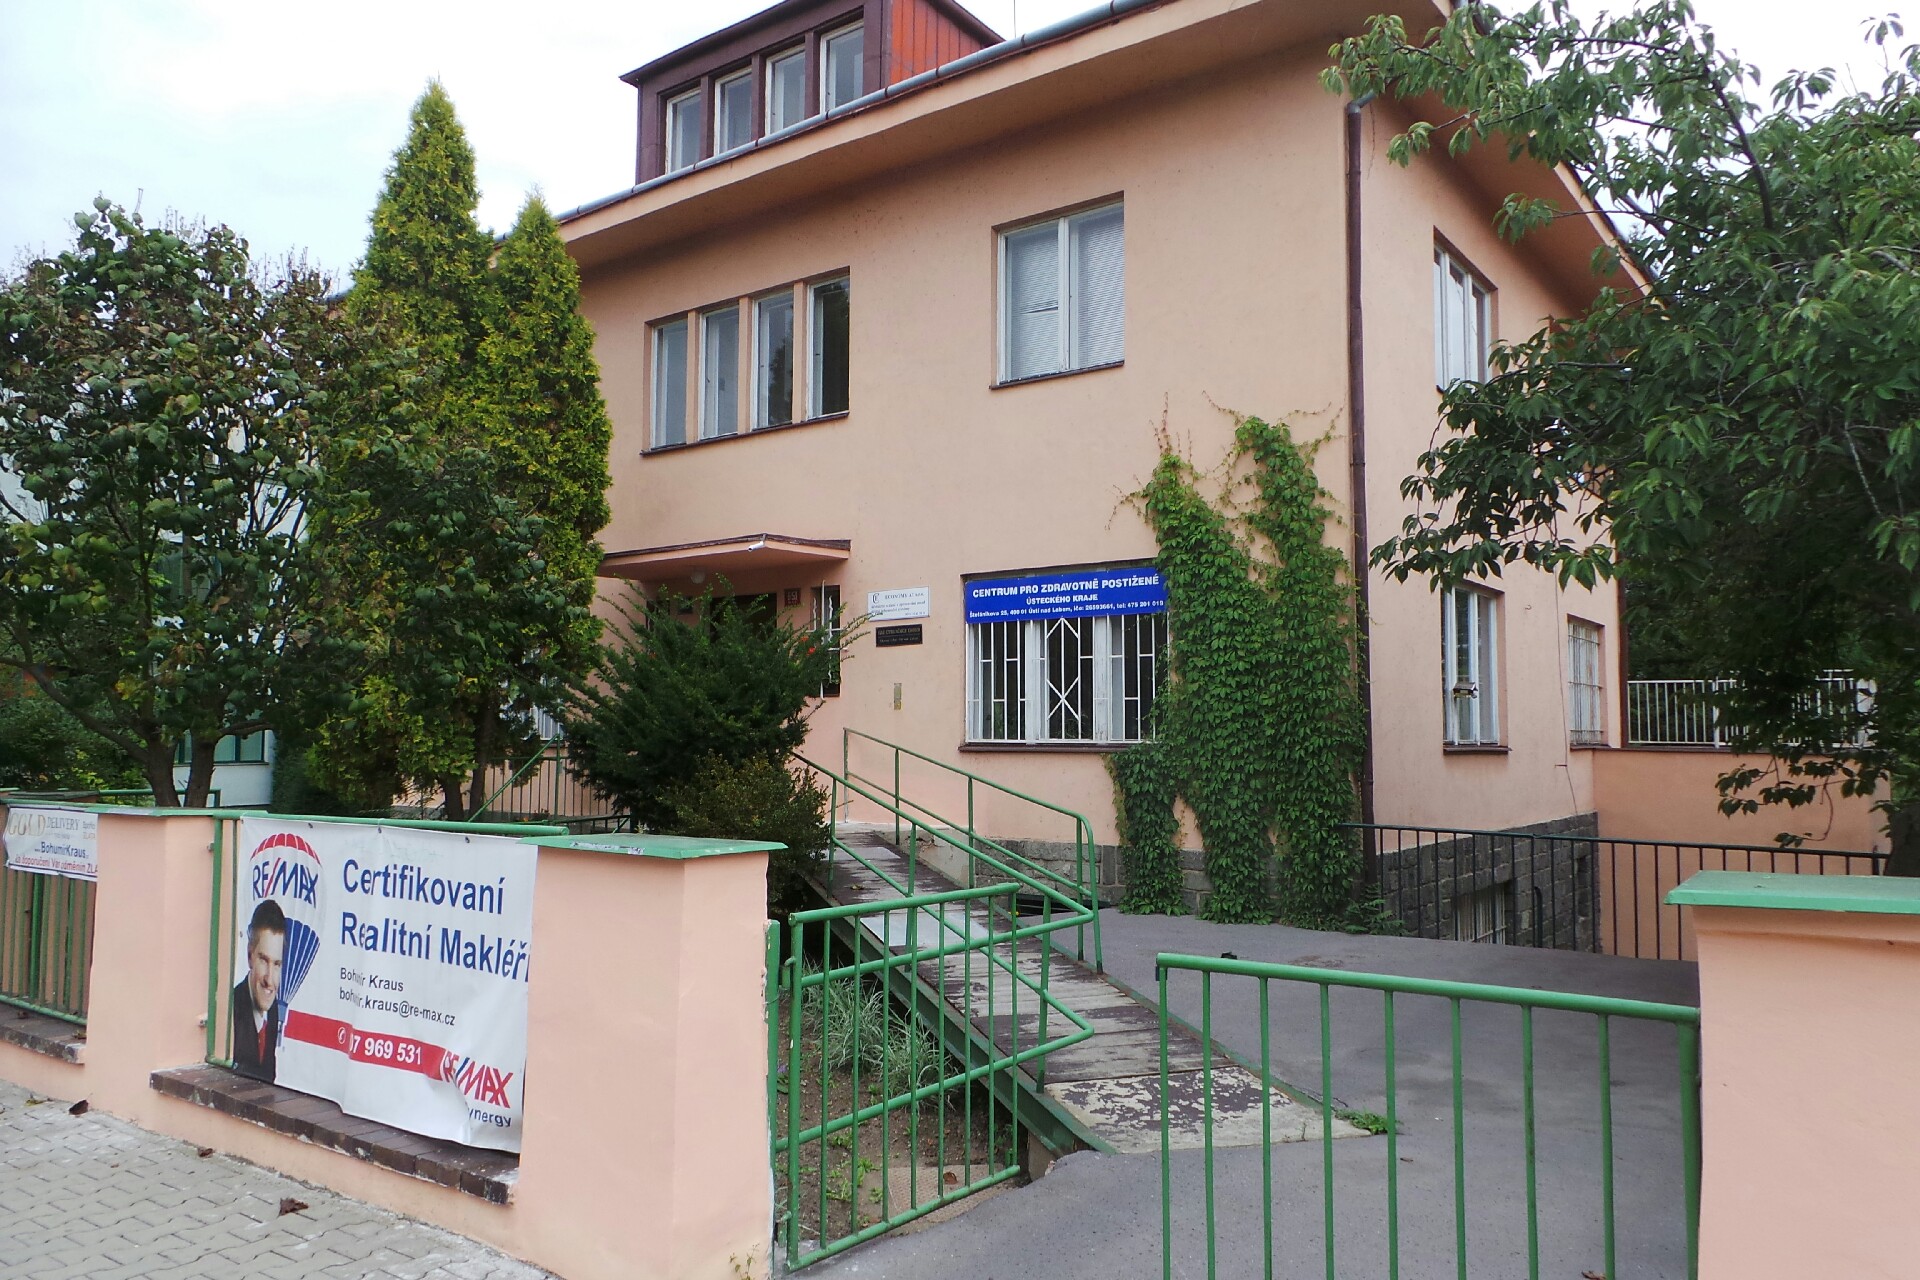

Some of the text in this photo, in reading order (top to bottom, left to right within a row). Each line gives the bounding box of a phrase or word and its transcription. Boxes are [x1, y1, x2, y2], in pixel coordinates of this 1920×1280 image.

[972, 573, 1160, 598] CENTRUM PRO ZDRAVOTNĚ POSTIŽENÉ
[1026, 593, 1099, 605] ÚSTECKÉHO KRAJE
[1052, 604, 1073, 613] Labem,
[8, 813, 46, 837] GOLD
[46, 815, 80, 831] DELIVERY
[253, 857, 319, 909] RE/MAX
[343, 859, 506, 915] Certifikovaní
[341, 911, 433, 960] Realitní
[369, 974, 404, 992] Kraus
[364, 1037, 394, 1059] 969
[396, 1042, 421, 1065] 531
[443, 1050, 514, 1109] RE/MAX
